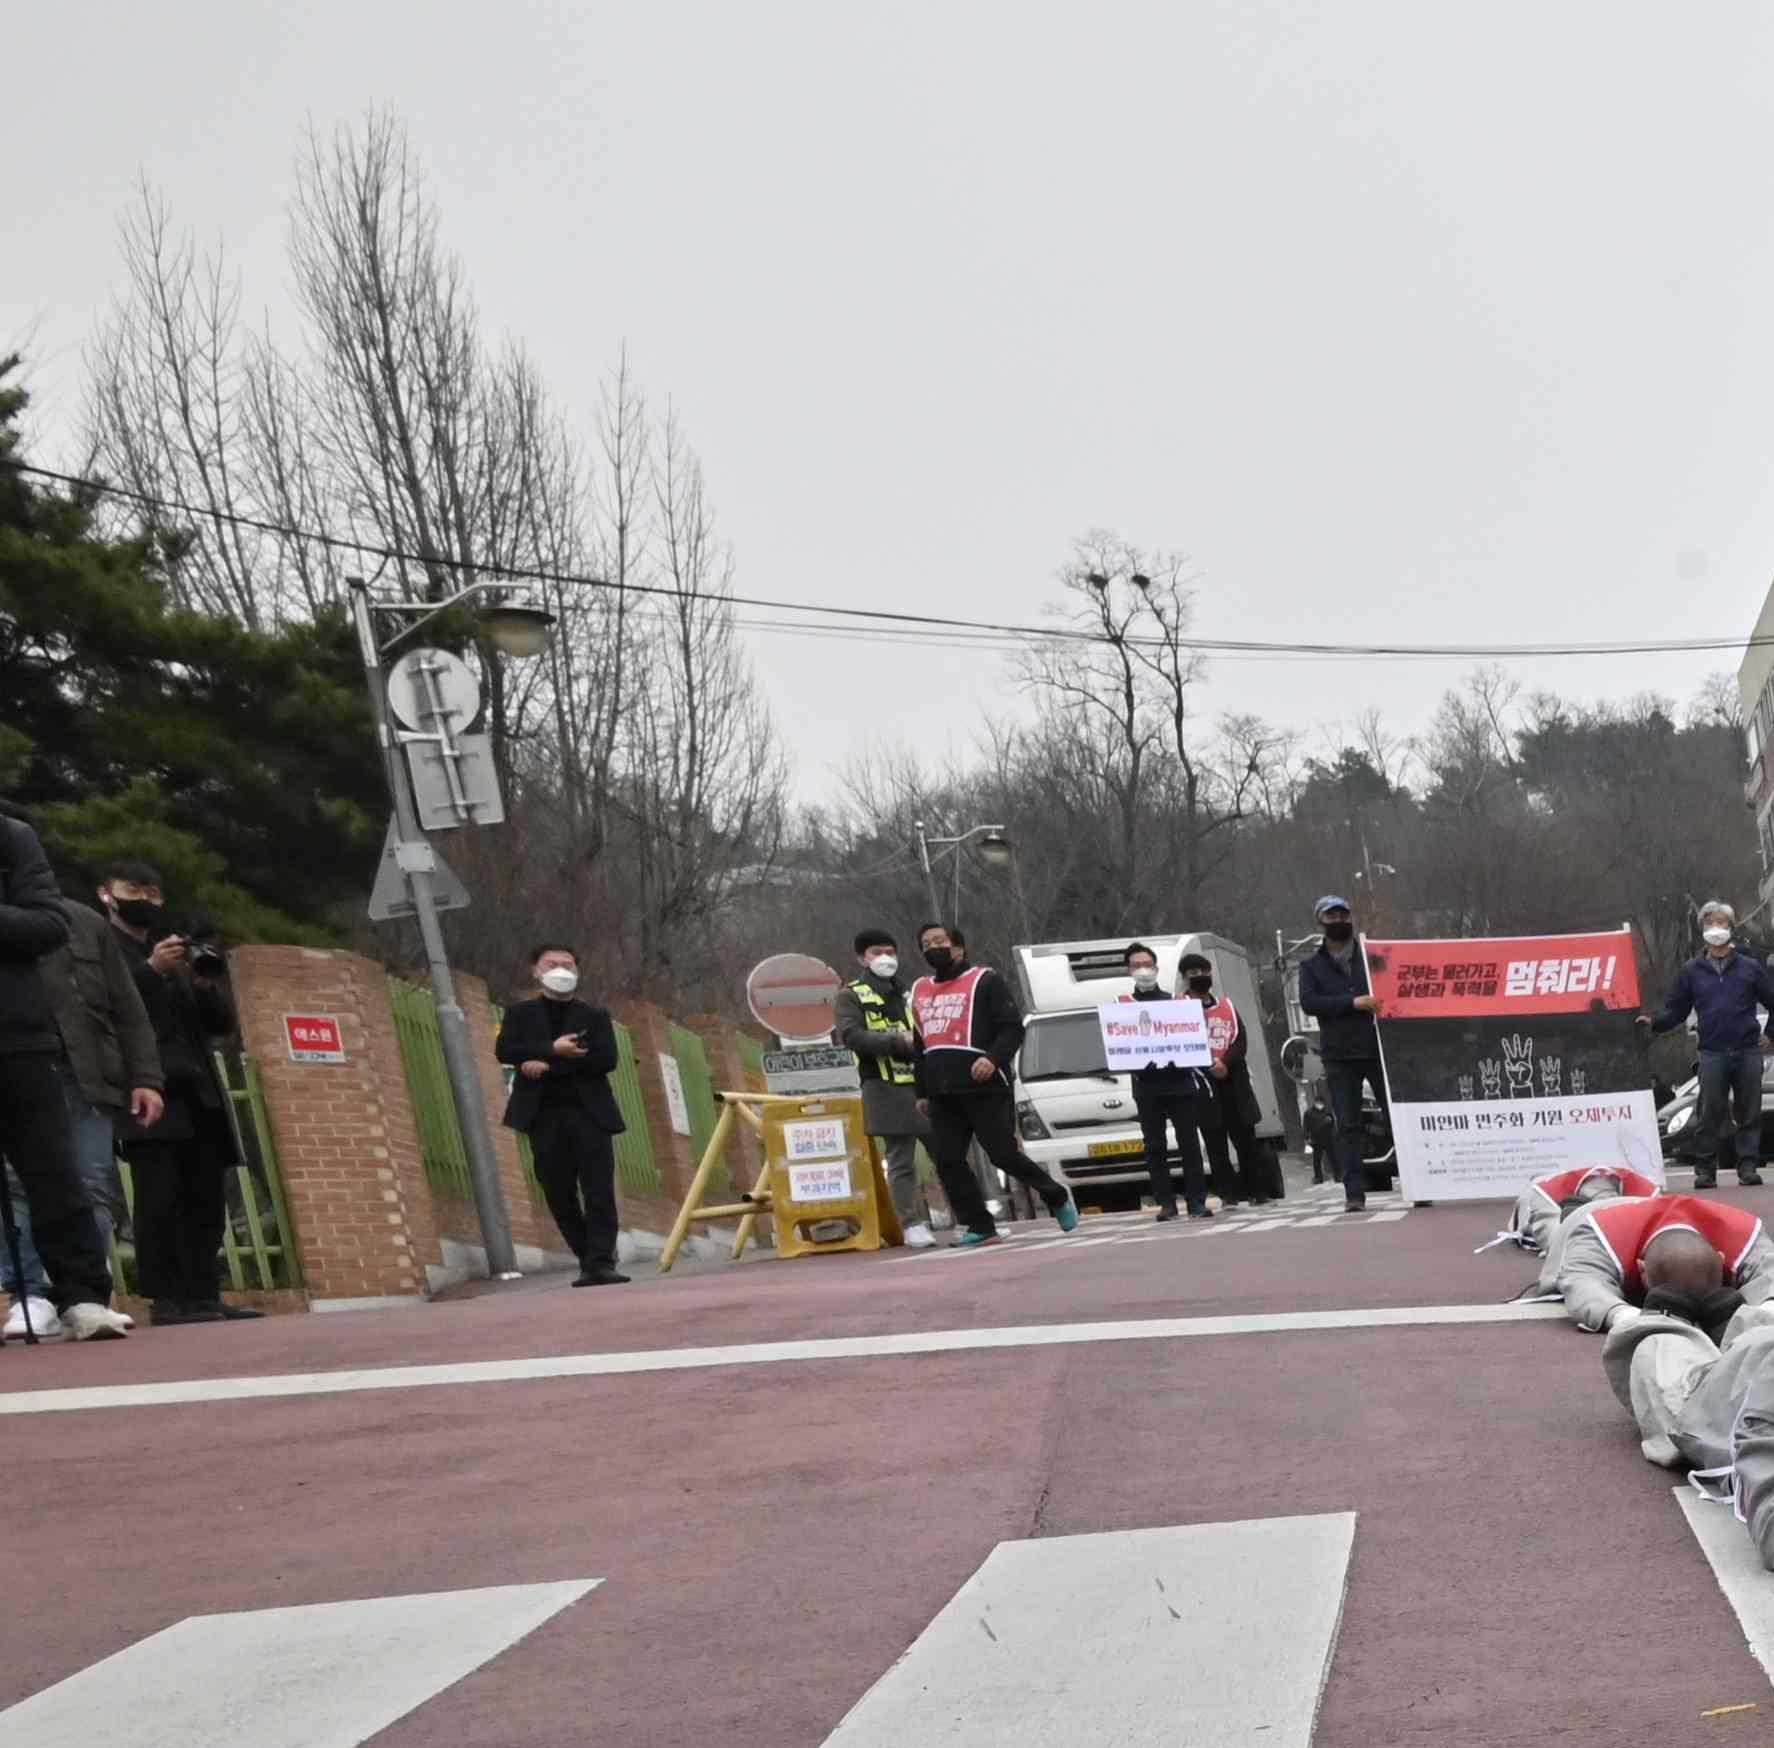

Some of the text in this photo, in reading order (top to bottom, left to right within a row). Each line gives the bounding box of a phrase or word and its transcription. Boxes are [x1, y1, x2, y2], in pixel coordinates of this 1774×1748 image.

[1397, 964, 1439, 981] 군부는
[1505, 955, 1617, 997] 멈춰라!
[294, 1027, 333, 1042] 에스원
[1106, 1022, 1138, 1037] #Save
[1153, 1019, 1201, 1037] Myanmar
[766, 1054, 804, 1073] 어린이
[1420, 1114, 1470, 1132] 미얀마
[1475, 1112, 1525, 1130] 민주화
[1531, 1109, 1564, 1127] 기원
